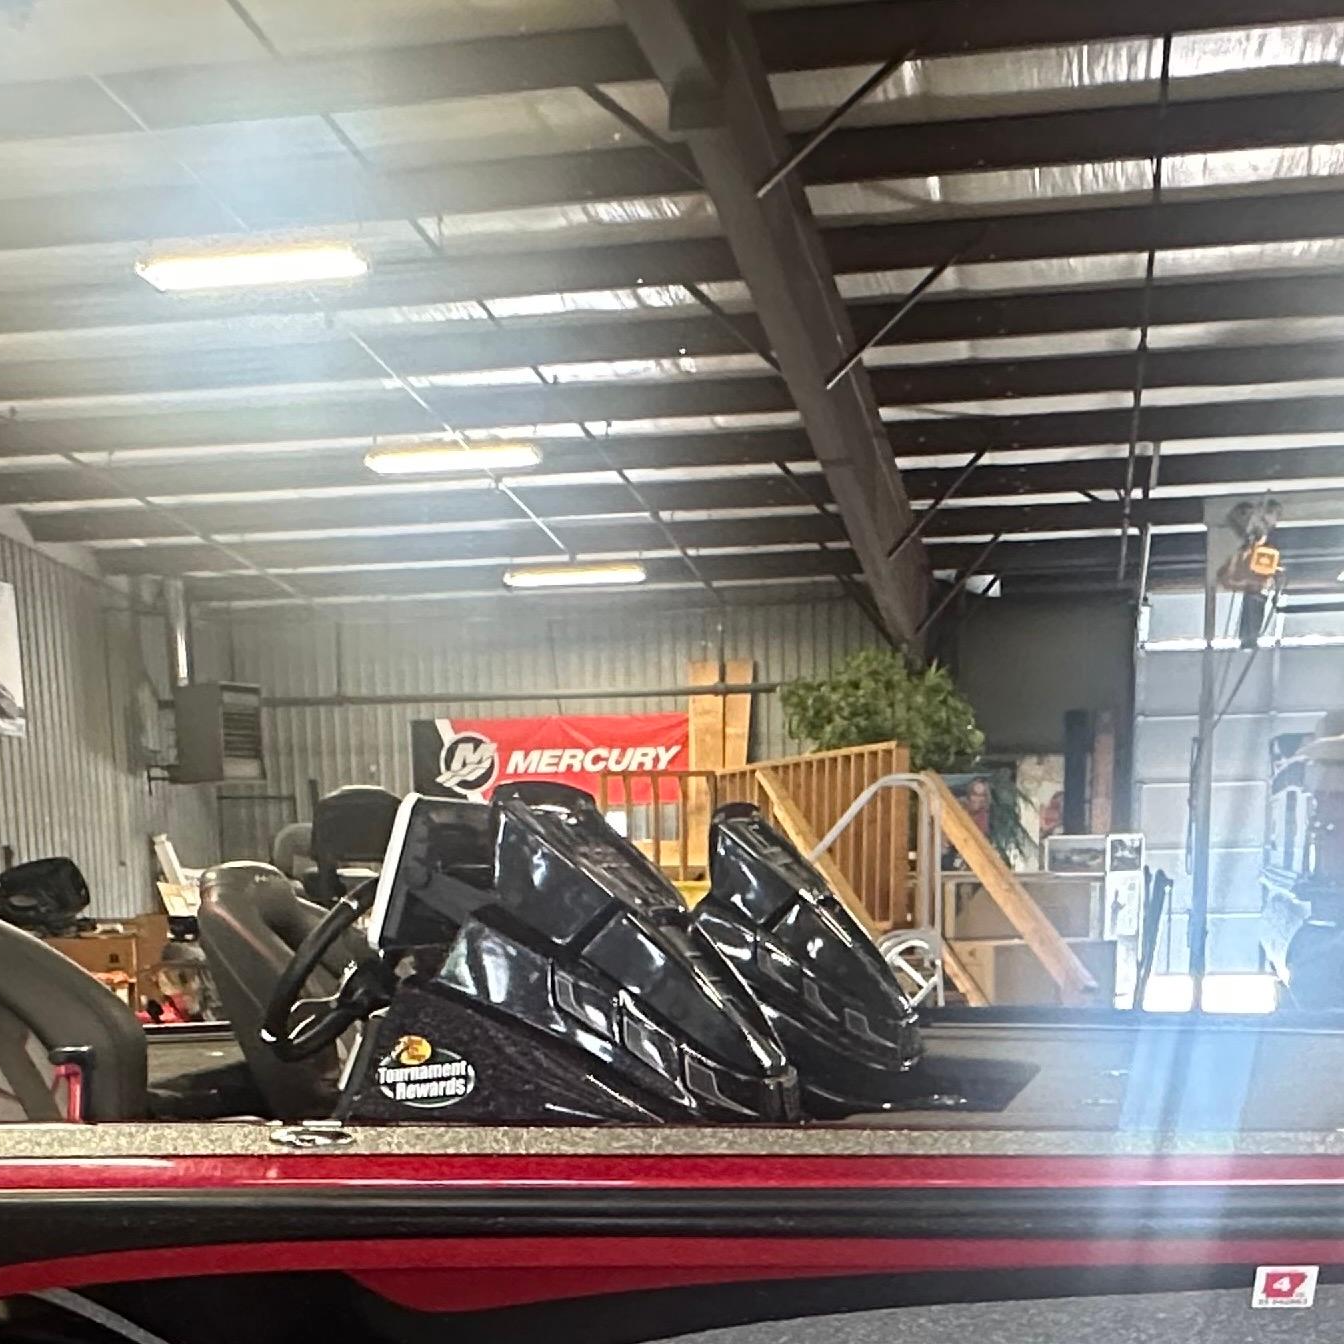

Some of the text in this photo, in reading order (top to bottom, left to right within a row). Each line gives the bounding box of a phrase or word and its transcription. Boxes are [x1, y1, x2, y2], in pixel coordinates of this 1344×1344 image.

[506, 745, 681, 774] MERCURY
[377, 1060, 467, 1085] Tournament
[396, 1077, 466, 1101] Rewards
